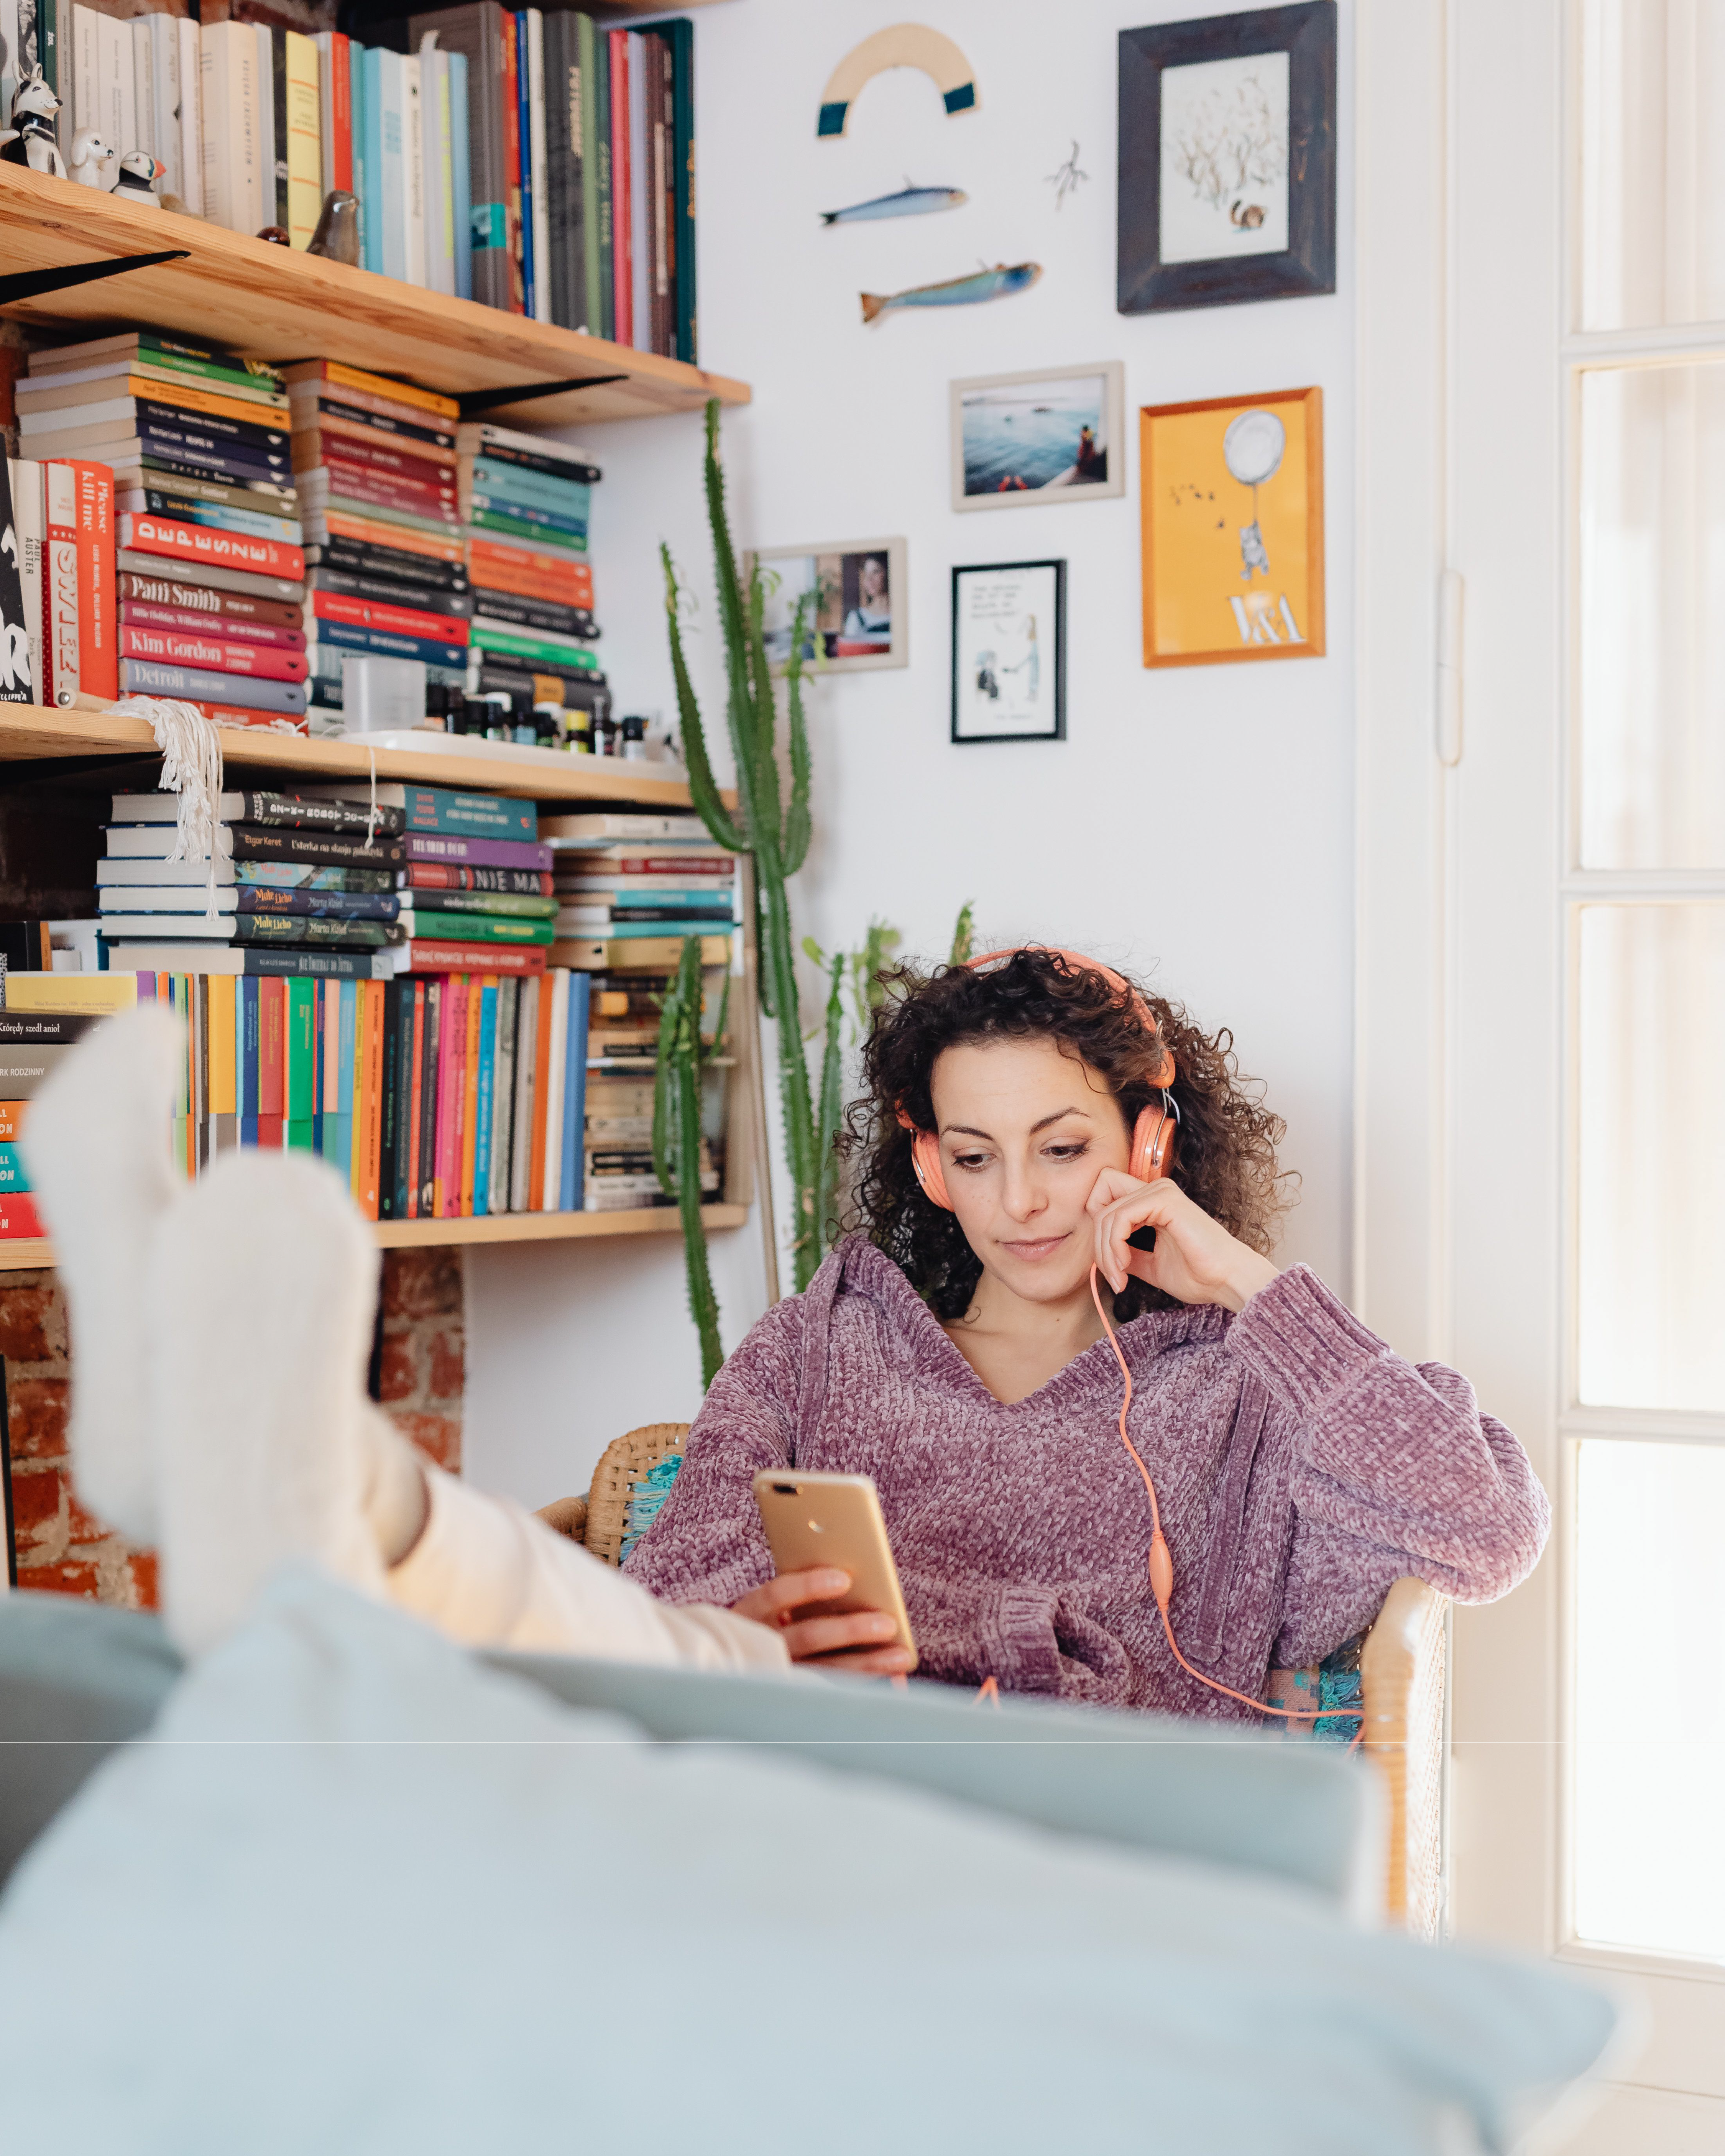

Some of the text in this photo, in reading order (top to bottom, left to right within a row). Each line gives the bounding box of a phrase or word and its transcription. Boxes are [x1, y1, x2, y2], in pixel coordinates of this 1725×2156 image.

[82, 470, 95, 531] kill me
[98, 481, 108, 534] Please
[138, 522, 267, 562] DEPESZE
[25, 537, 34, 575] AUSTER
[131, 575, 169, 604] Patti
[172, 583, 222, 612] Smith
[1226, 592, 1306, 645] V&A
[131, 631, 164, 654] Kim
[166, 636, 222, 663] Gordon
[134, 664, 185, 689] Detroit
[0, 690, 27, 701] CLIFFE'A
[306, 808, 342, 820] ROBOT
[245, 834, 263, 847] Etgar
[264, 836, 283, 847] Keret
[475, 869, 541, 894] NIE MA
[274, 892, 292, 905] Licho
[273, 919, 292, 930] Licho
[25, 1023, 42, 1032] szedł
[43, 1023, 60, 1033] anioł
[10, 1068, 45, 1076] RODZINNY
[0, 1170, 14, 1181] ON
[0, 1218, 8, 1229] N
